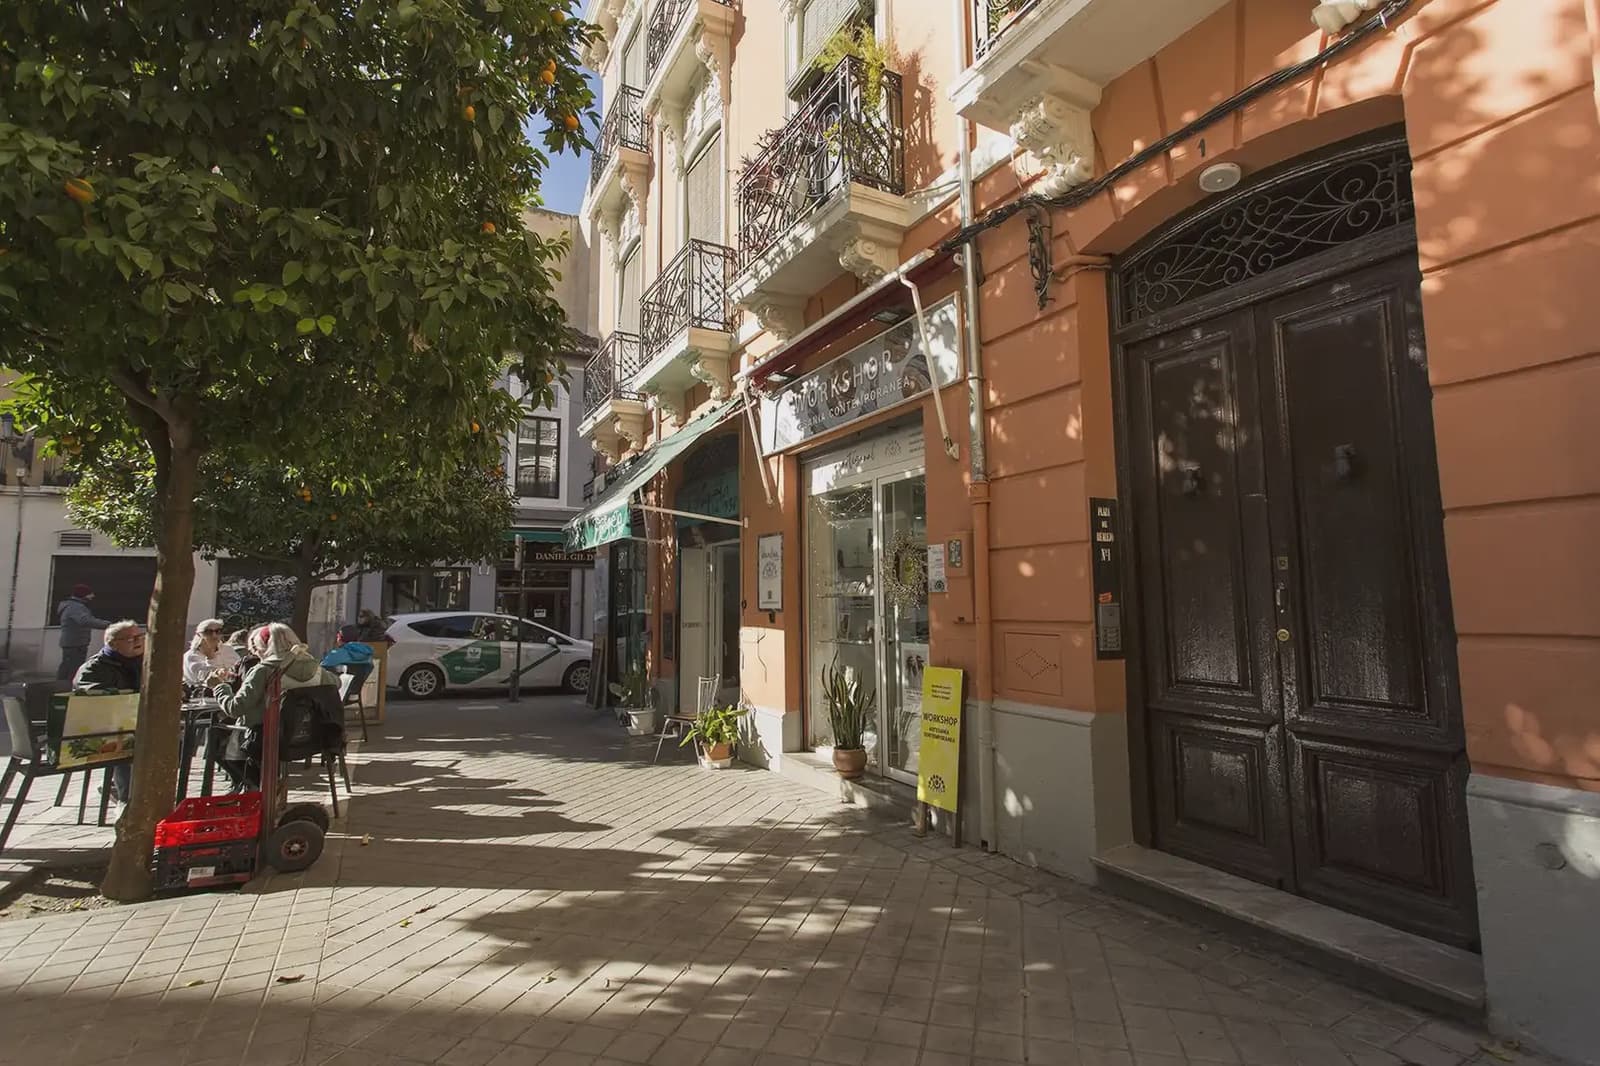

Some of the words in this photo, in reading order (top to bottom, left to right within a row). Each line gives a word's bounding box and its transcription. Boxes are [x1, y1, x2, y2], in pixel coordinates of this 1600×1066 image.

[1197, 138, 1206, 158] 1
[535, 552, 569, 561] DANIEL
[922, 712, 959, 726] WORKSHOP
